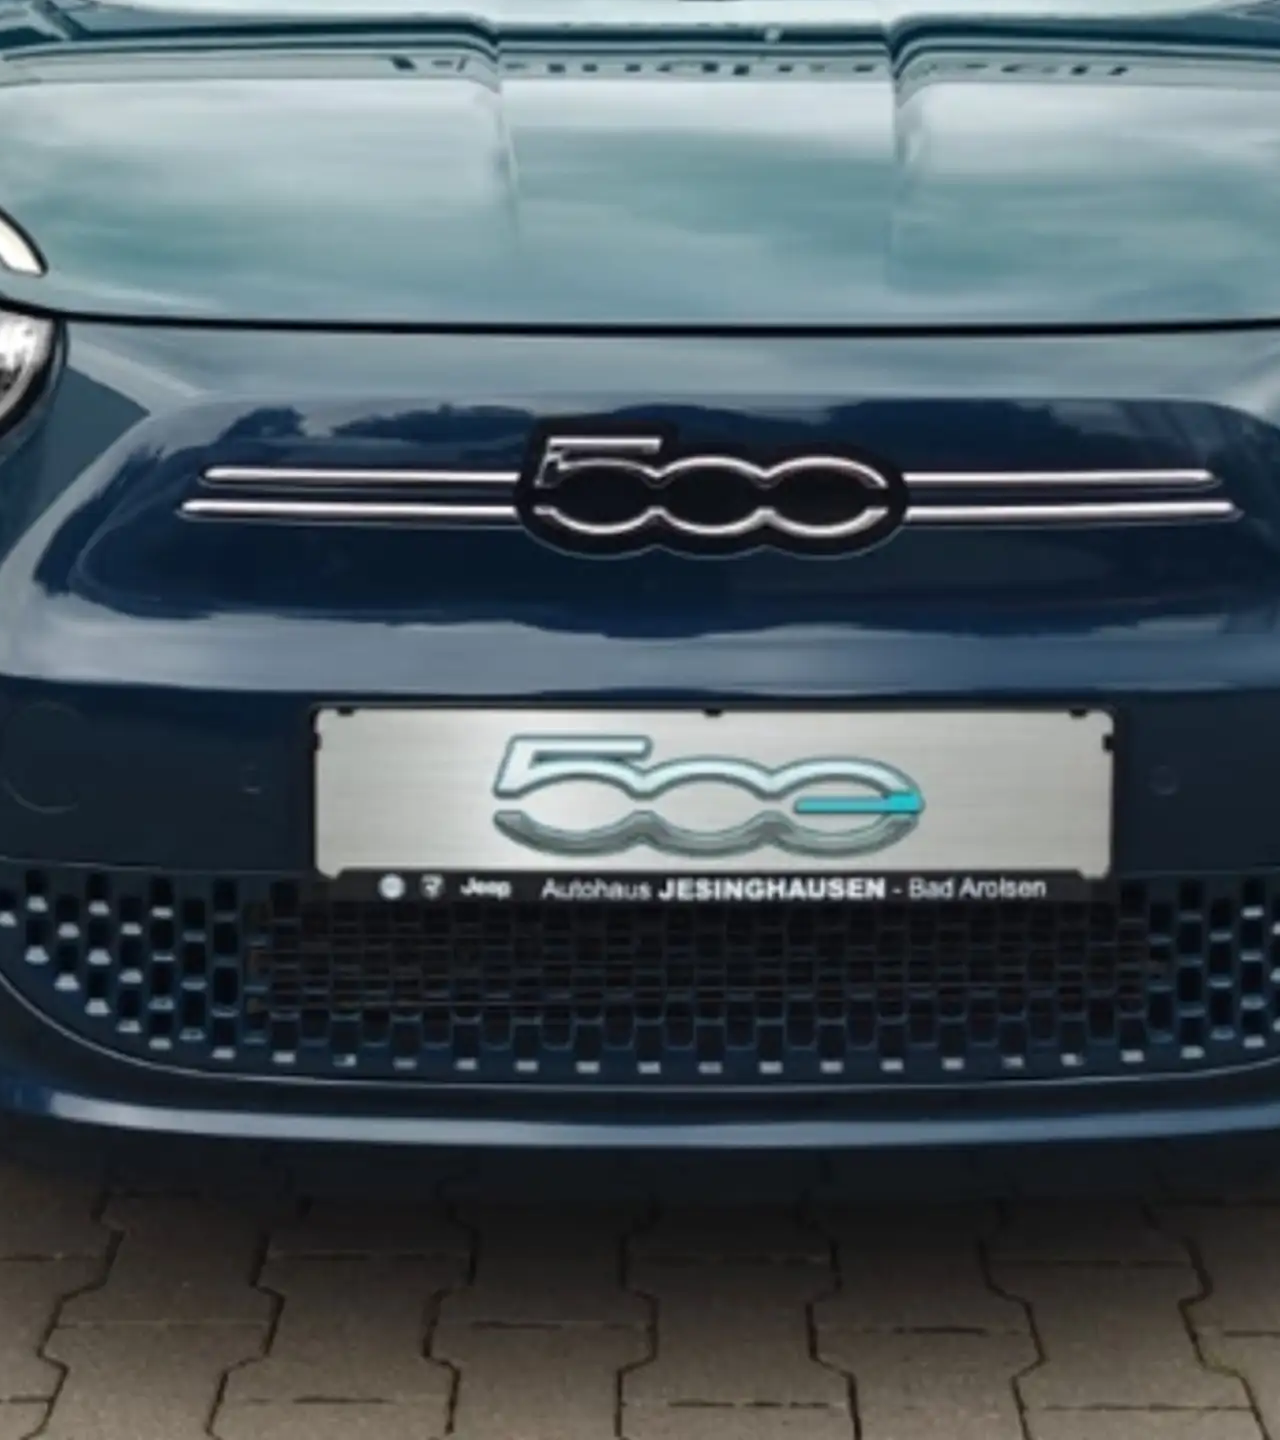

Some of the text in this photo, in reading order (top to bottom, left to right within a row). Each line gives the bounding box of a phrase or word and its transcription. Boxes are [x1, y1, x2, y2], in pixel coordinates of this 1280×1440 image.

[535, 436, 888, 537] 500
[541, 877, 651, 901] Autohaus
[658, 877, 886, 900] JESINGHAUSEN
[908, 877, 954, 898] Bad
[960, 876, 1047, 899] Arolsen
